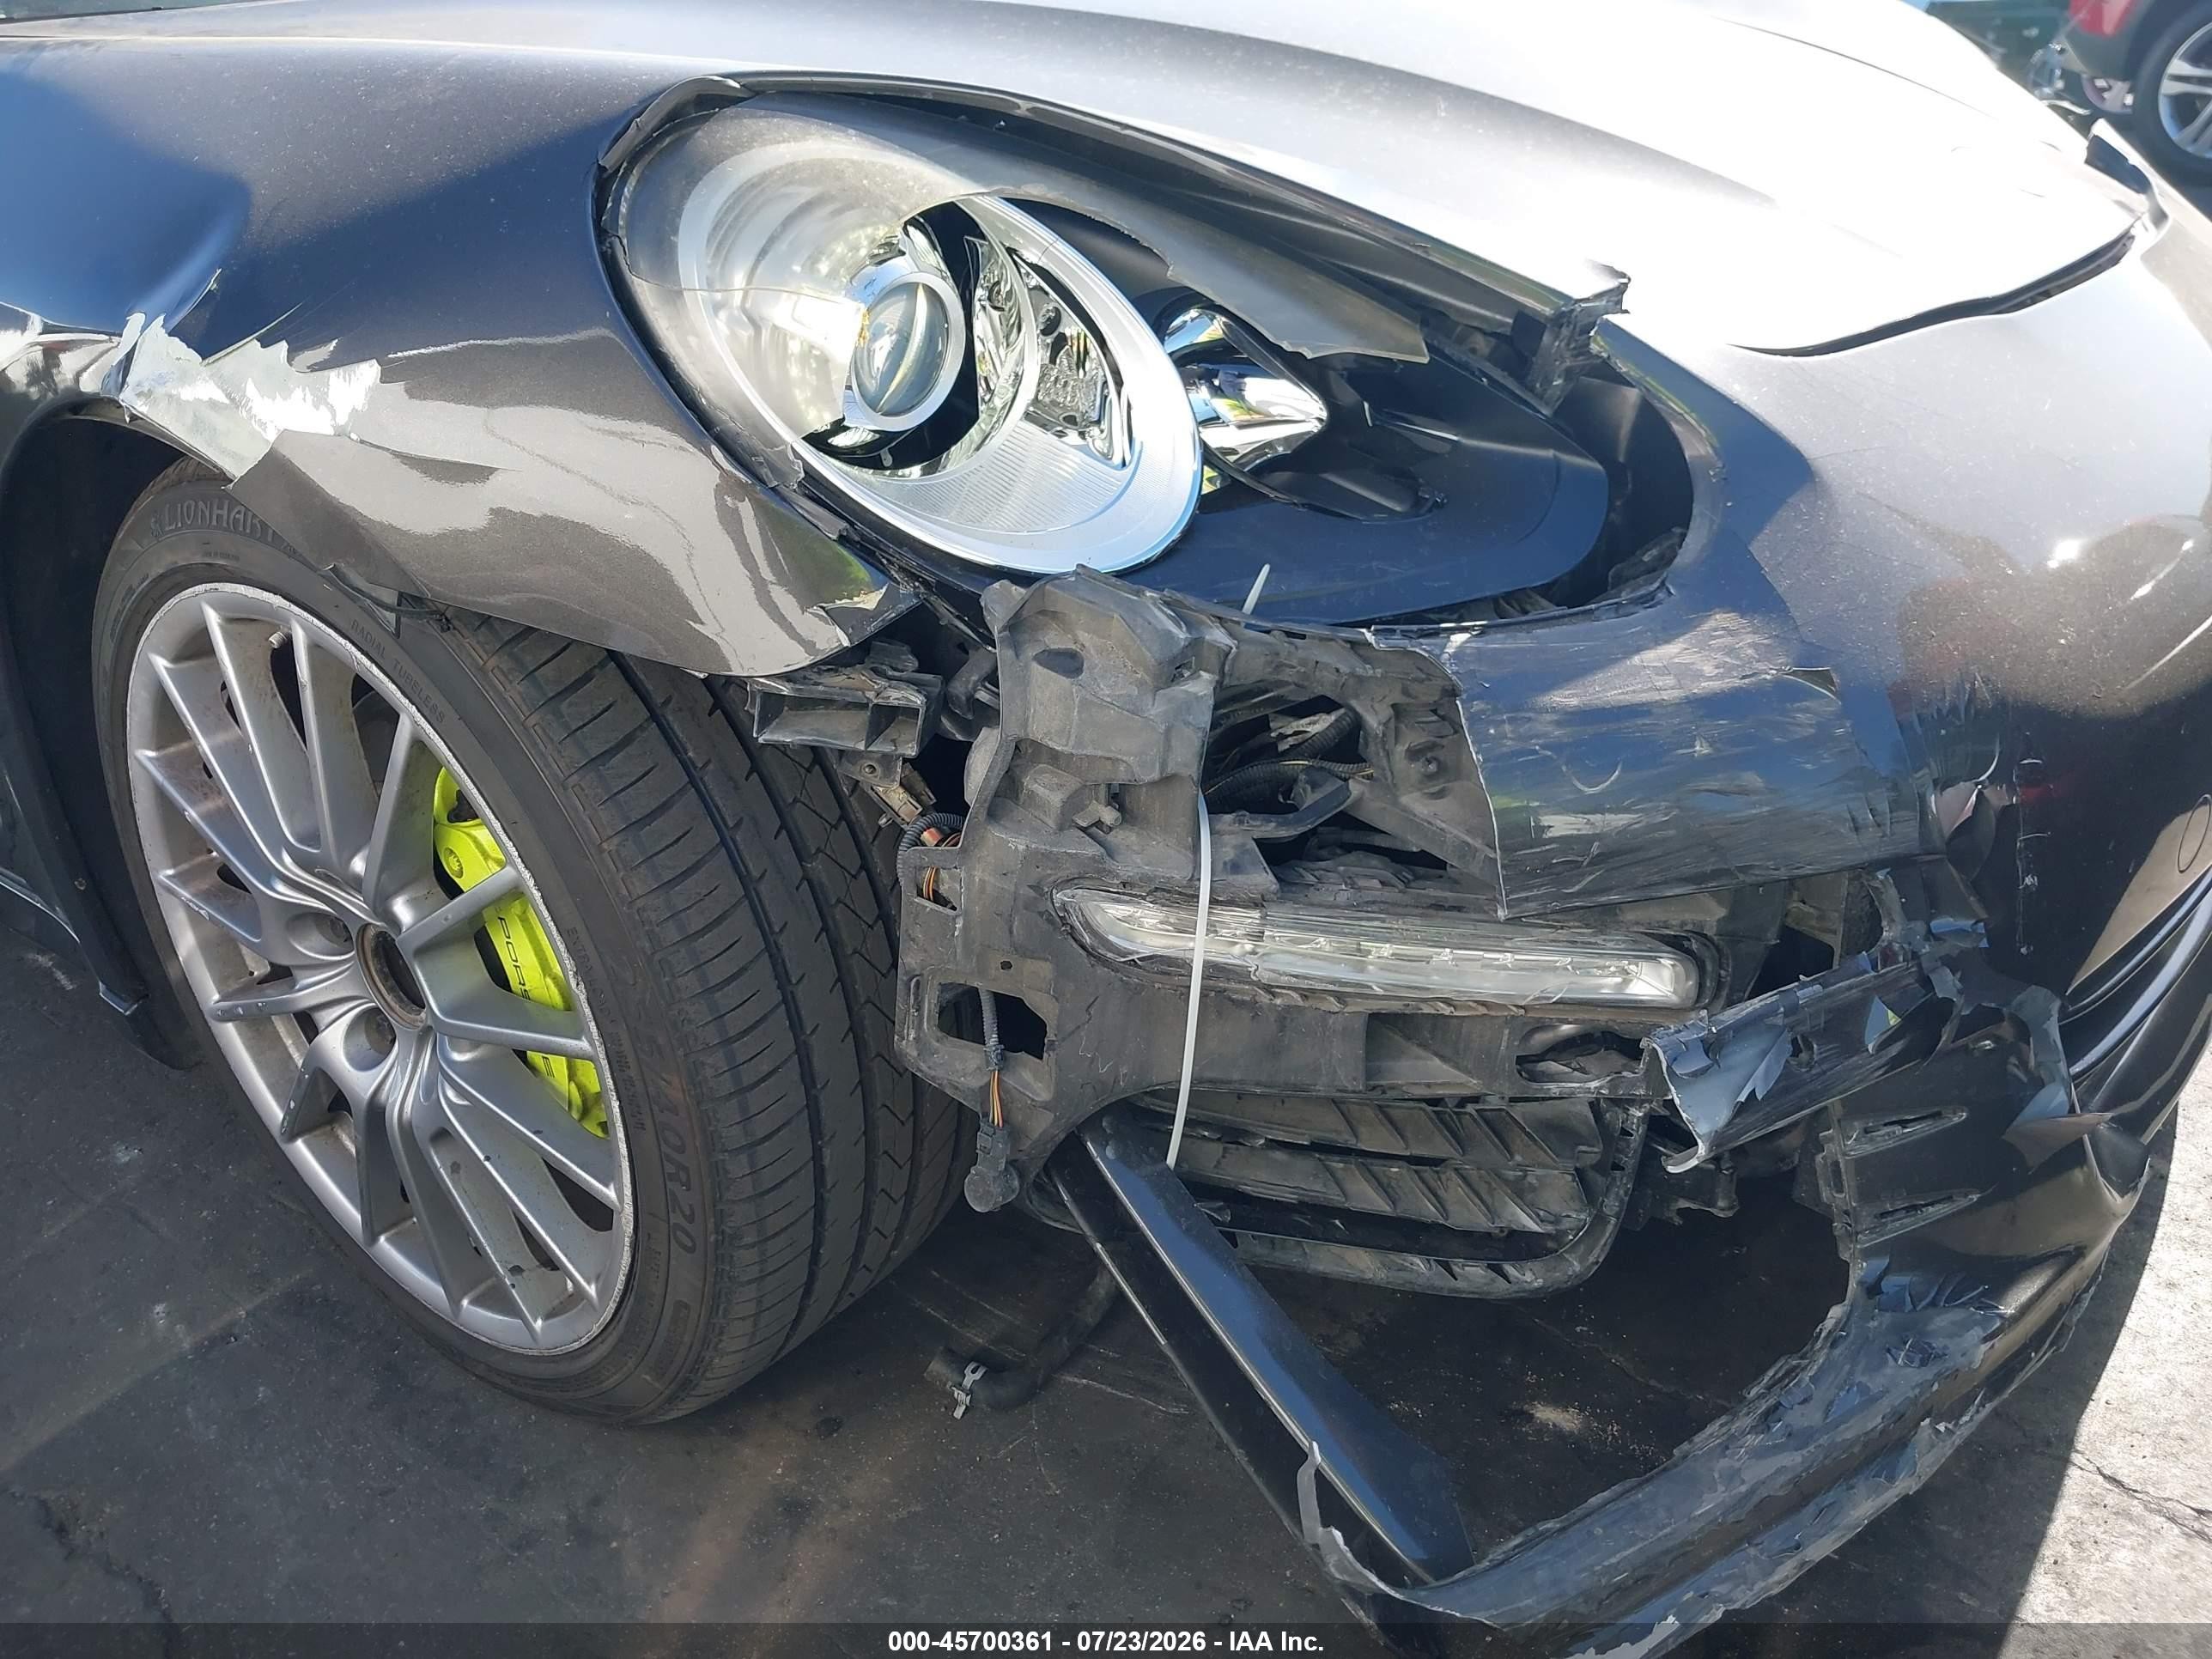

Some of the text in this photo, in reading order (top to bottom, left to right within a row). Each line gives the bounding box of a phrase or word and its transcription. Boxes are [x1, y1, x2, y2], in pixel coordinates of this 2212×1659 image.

[350, 619, 446, 723] RADIAL TUBELESS
[497, 916, 555, 1079] PORSE
